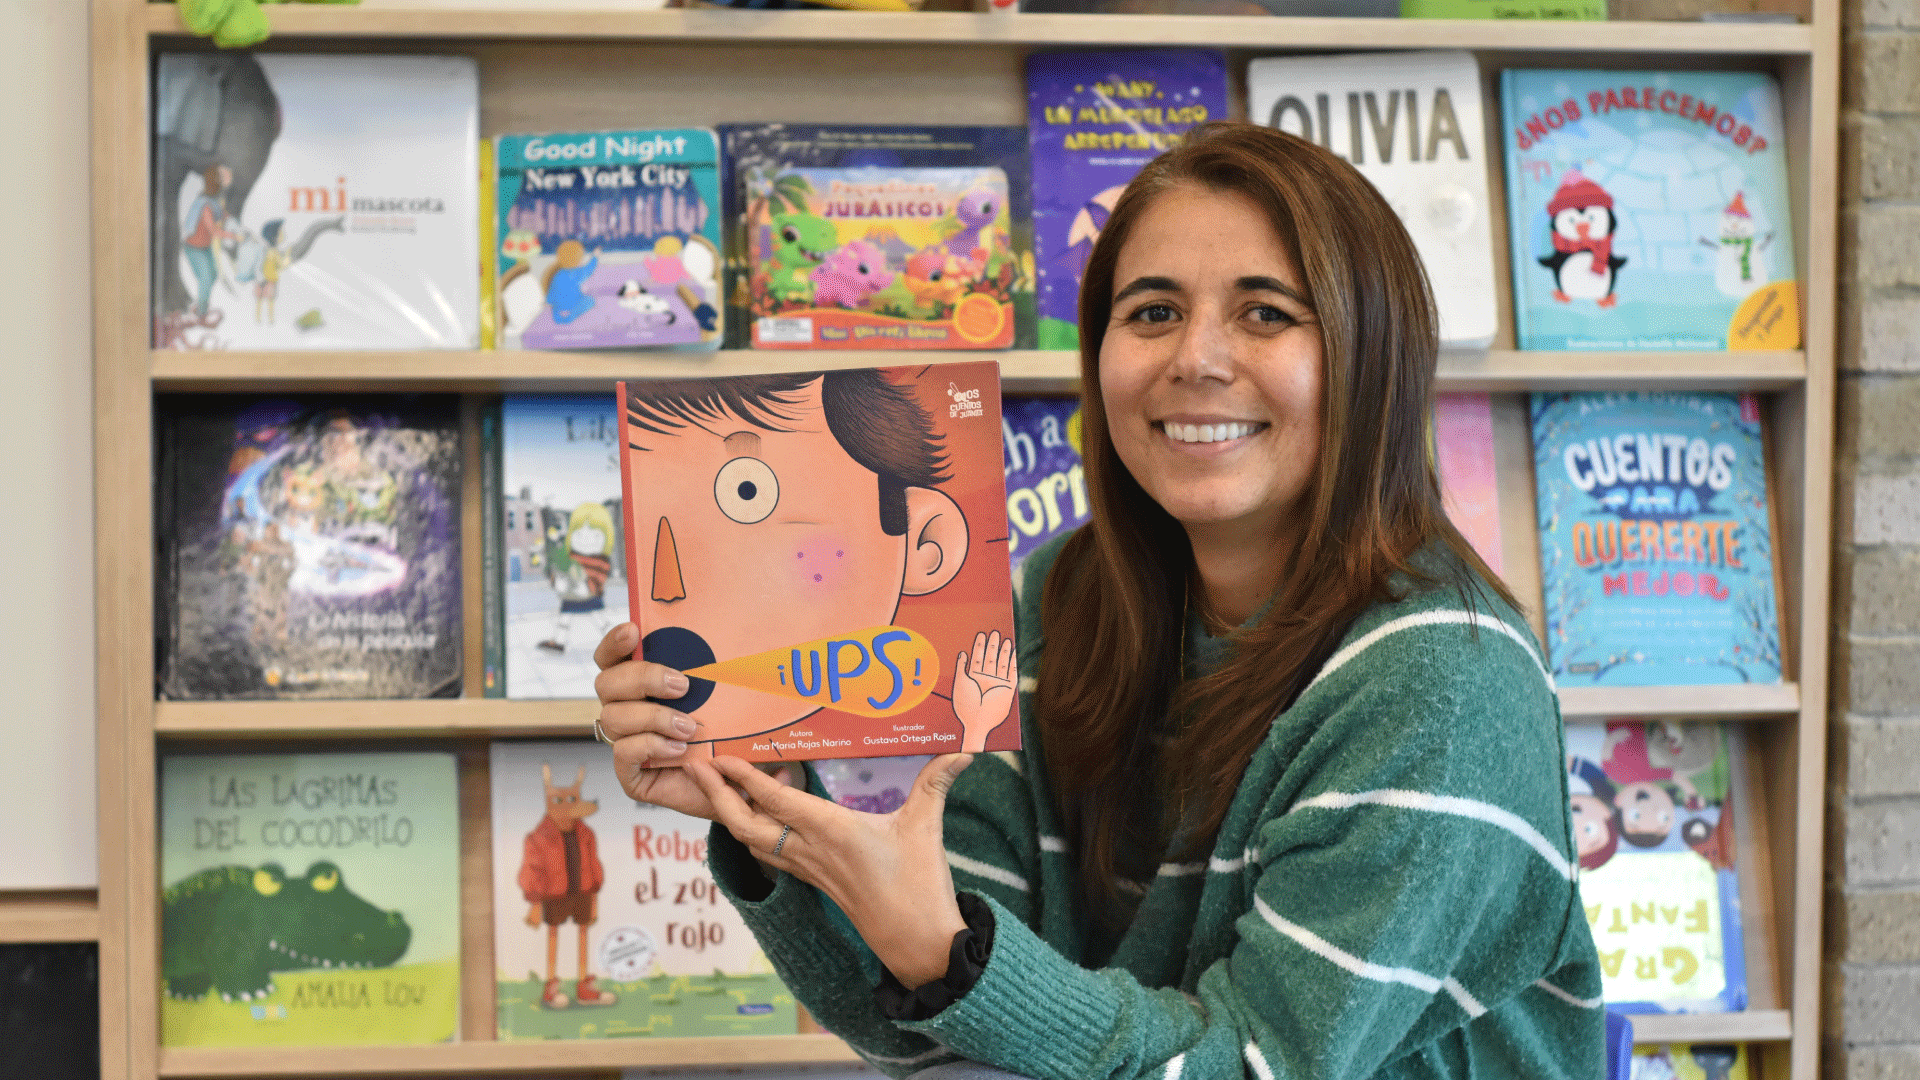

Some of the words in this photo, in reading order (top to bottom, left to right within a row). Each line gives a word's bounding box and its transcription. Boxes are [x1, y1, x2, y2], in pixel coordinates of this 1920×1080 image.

[1269, 87, 1471, 166] OLIVIA
[1587, 86, 1768, 155] PARECEMOS?
[523, 137, 597, 161] Good
[604, 134, 689, 163] Night
[288, 176, 347, 212] mi
[352, 197, 445, 213] mascota
[526, 168, 577, 191] New
[580, 165, 638, 189] York
[640, 163, 690, 190] City
[1563, 432, 1737, 492] CUENTOS
[1571, 519, 1743, 569] QUERERTE
[1602, 570, 1731, 601] MEJOR
[777, 630, 922, 710] ¡UPS!
[752, 742, 770, 751] Ana
[797, 740, 821, 751] Rojas
[789, 730, 813, 738] Autora
[863, 736, 899, 746] Gustavo
[900, 734, 932, 744] Ortega
[933, 733, 957, 743] Rojas
[892, 724, 926, 732] Ilustrador
[208, 774, 258, 809] LAS
[194, 814, 247, 851] DEL
[261, 811, 414, 849] COCODRILO
[666, 907, 725, 953] rojo
[291, 980, 372, 1009] AMALIA
